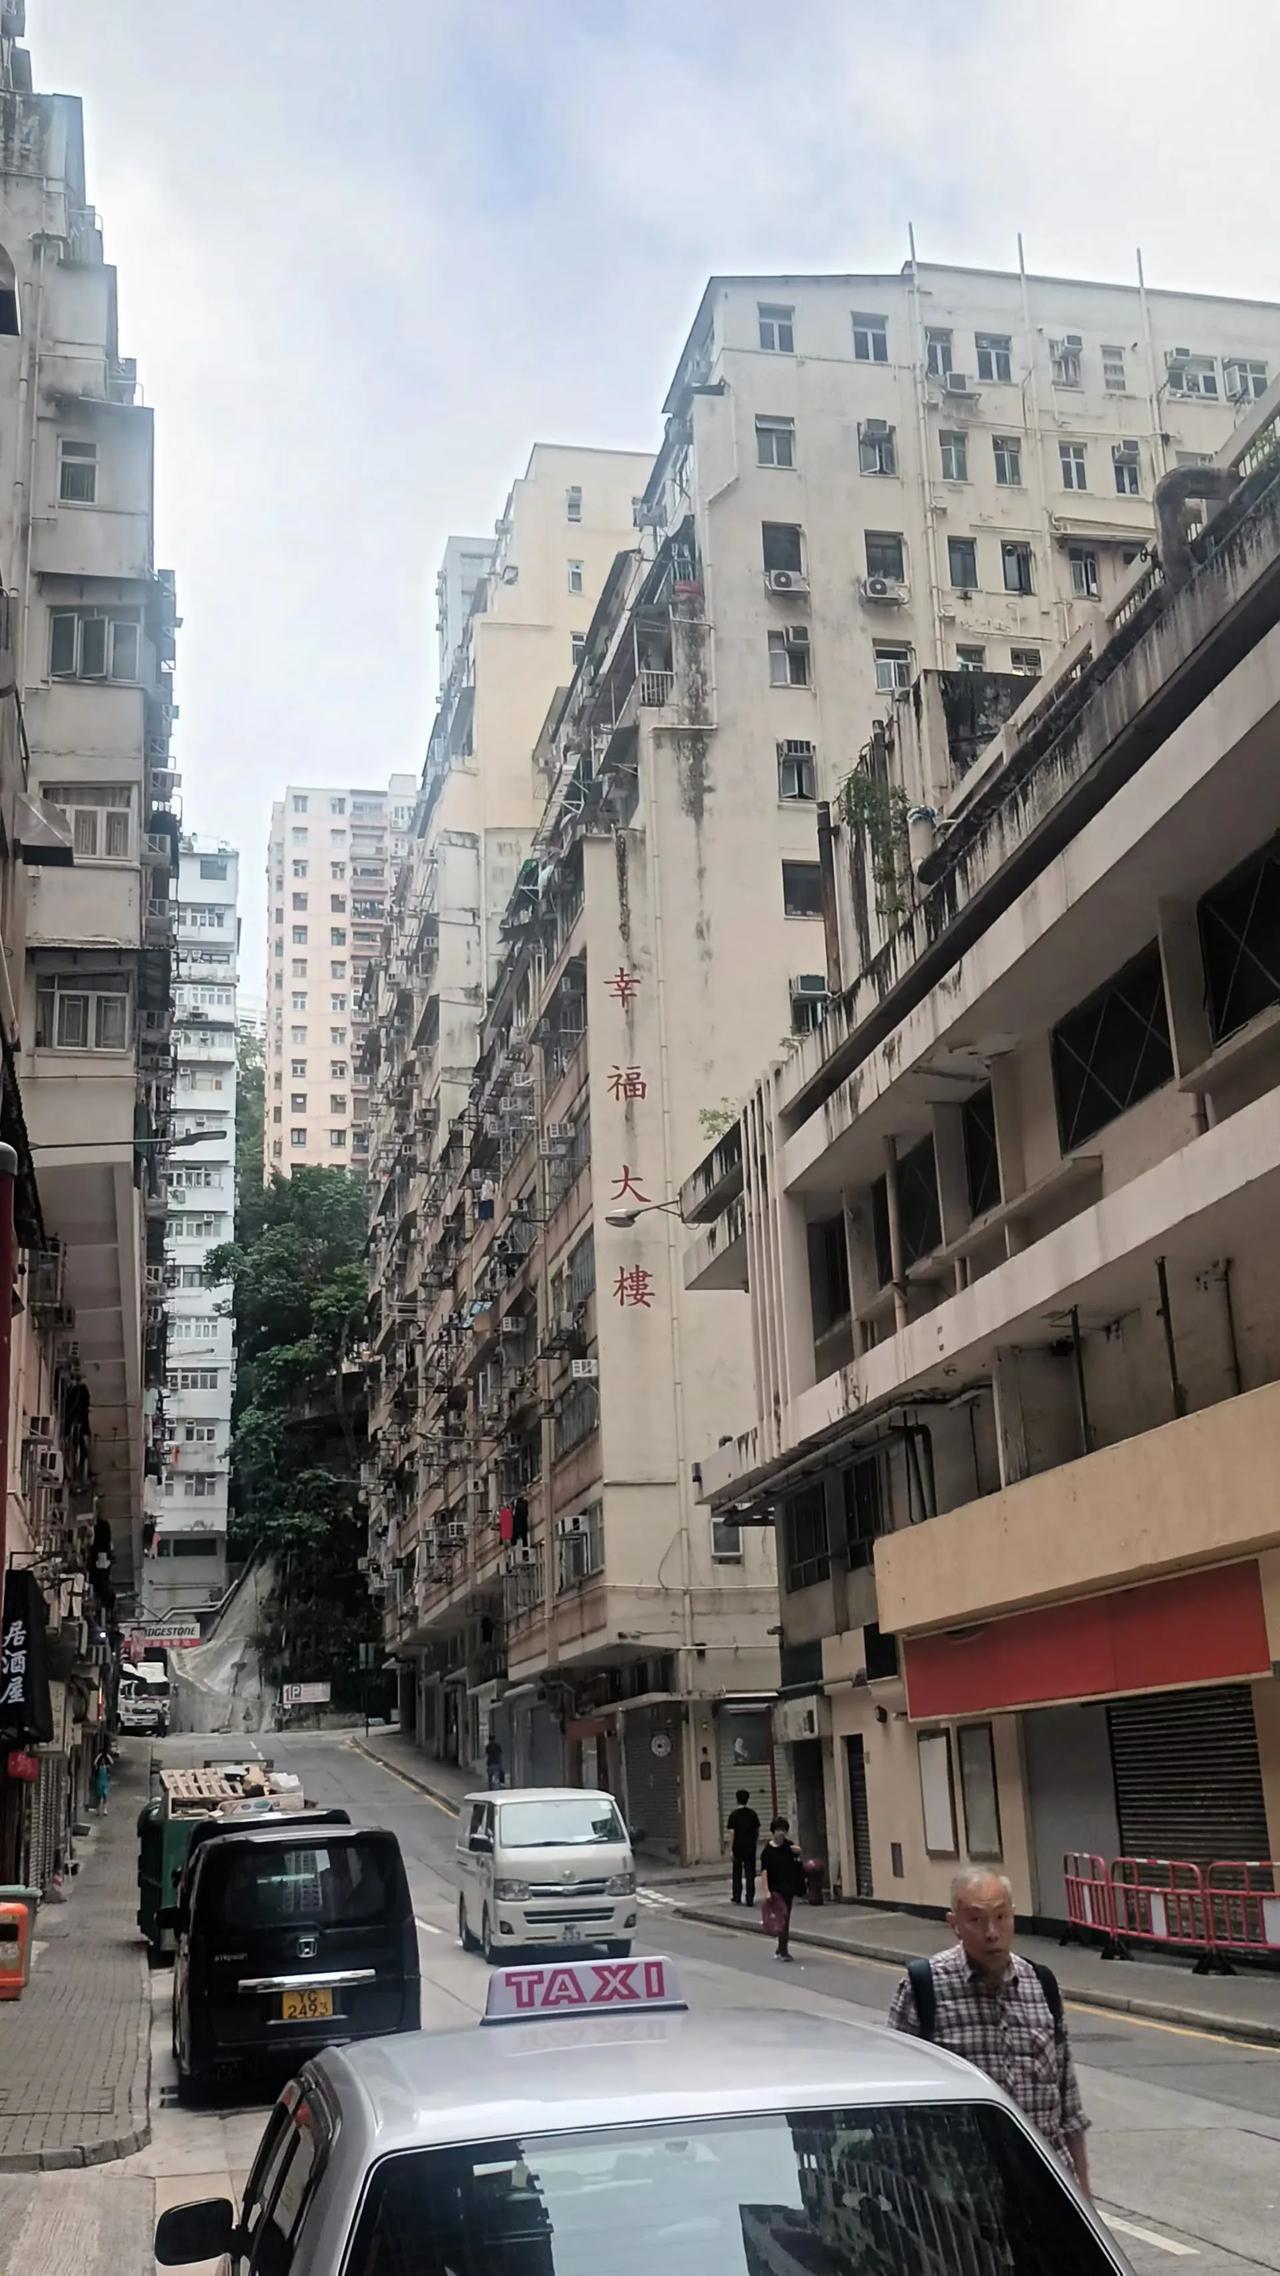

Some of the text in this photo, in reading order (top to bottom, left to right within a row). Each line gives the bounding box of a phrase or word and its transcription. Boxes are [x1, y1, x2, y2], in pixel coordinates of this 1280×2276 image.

[604, 966, 656, 1308] 幸福大樓
[1, 1620, 27, 1704] 居酒屋
[292, 1686, 300, 1698] P
[505, 1961, 665, 2008] TAXI
